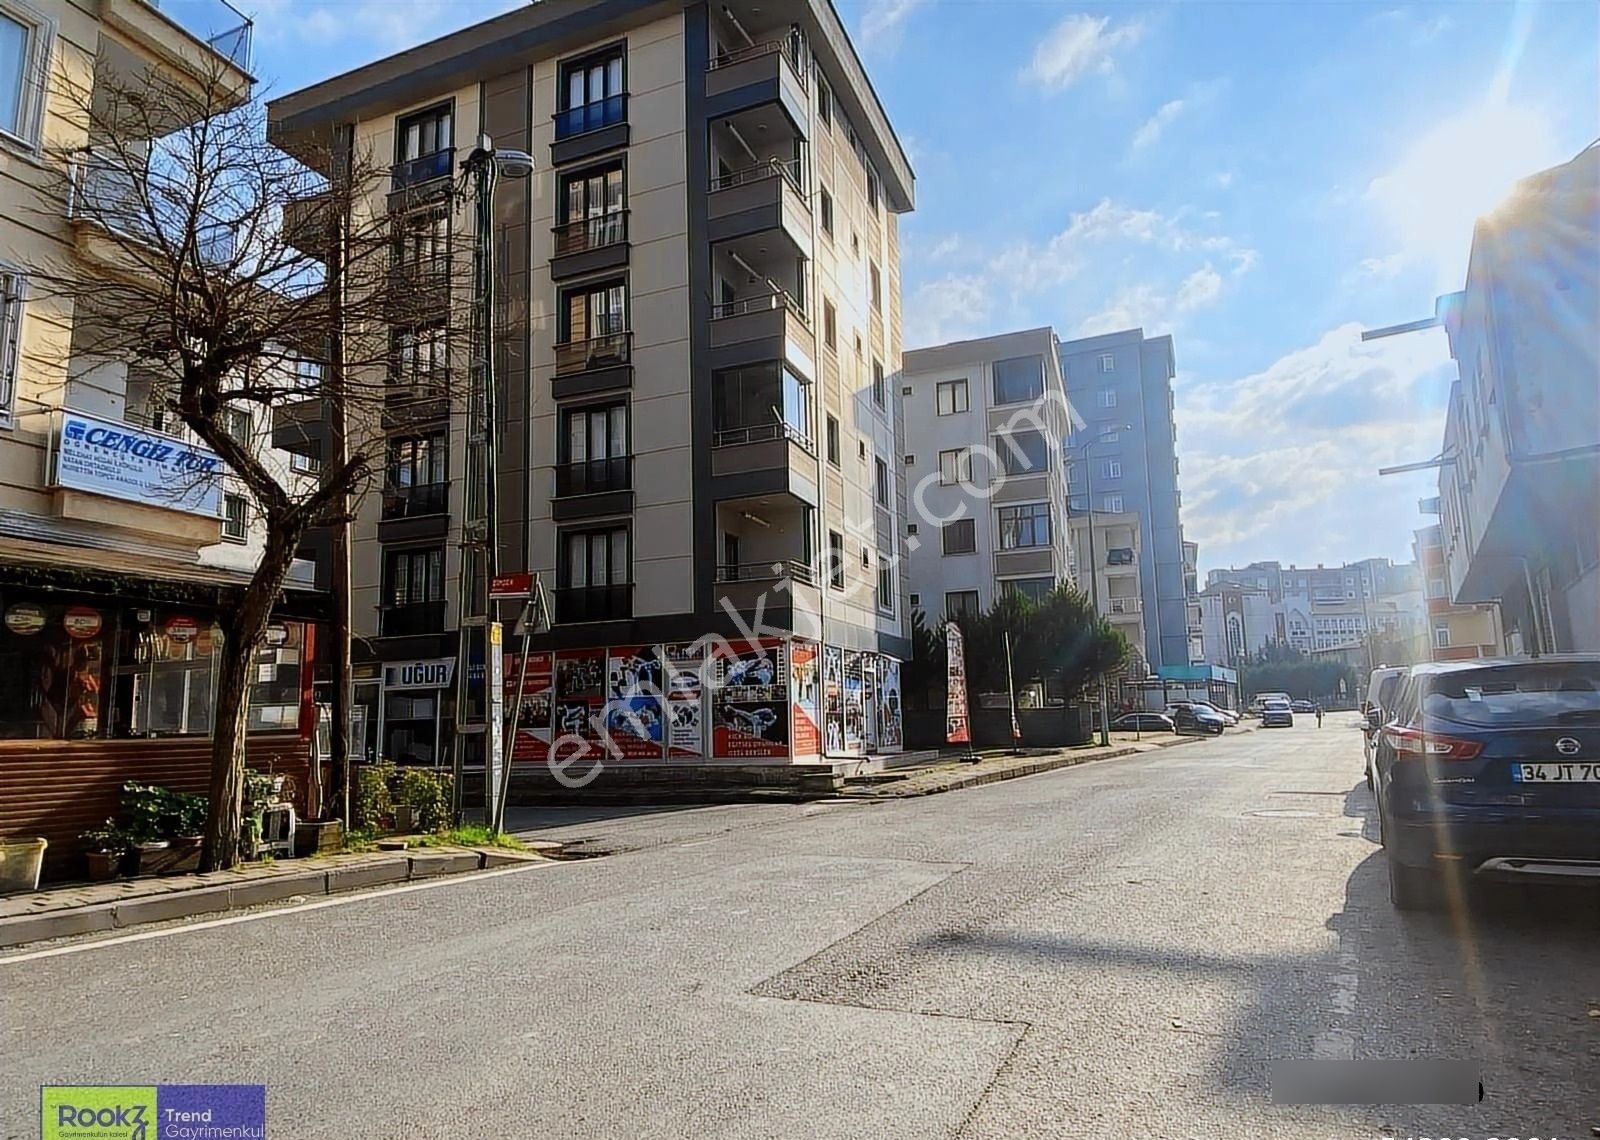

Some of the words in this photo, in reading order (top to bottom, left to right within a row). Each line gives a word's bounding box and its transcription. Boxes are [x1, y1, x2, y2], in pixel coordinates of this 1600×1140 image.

[85, 428, 174, 462] CENGİZ
[402, 662, 448, 685] UĞUR
[1522, 765, 1546, 781] 34
[1552, 765, 1574, 781] JT
